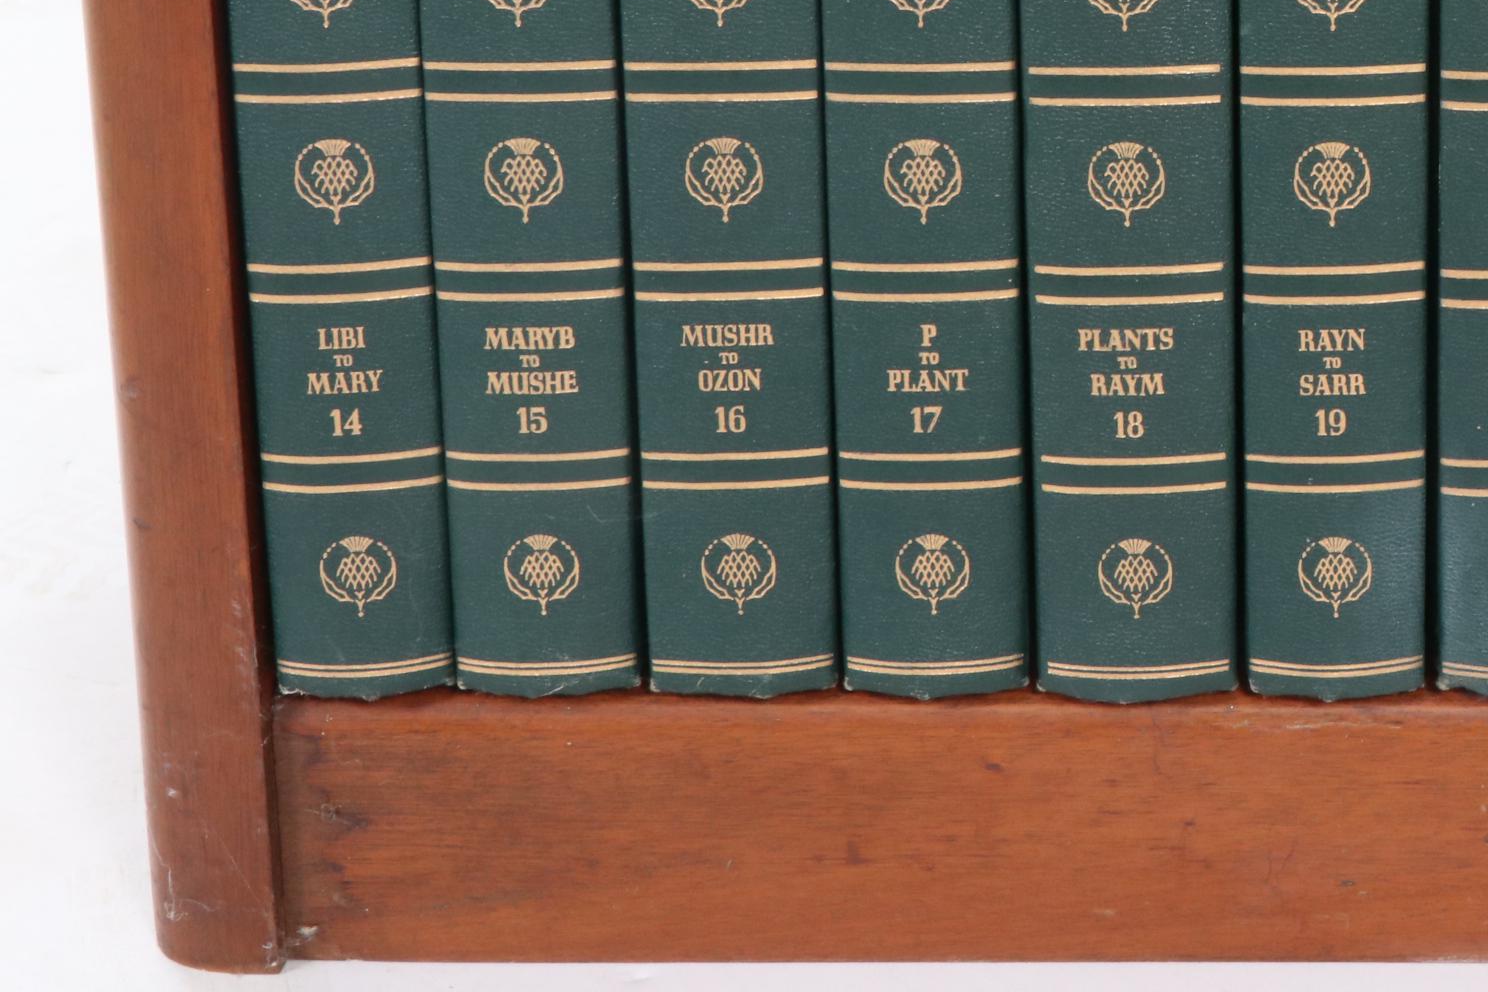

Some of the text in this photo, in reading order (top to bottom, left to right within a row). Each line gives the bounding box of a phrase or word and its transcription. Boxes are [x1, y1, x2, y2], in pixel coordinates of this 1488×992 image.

[319, 327, 365, 349] LIBI
[484, 326, 575, 350] MARYB
[681, 324, 774, 346] MUSHR
[920, 324, 937, 347] P
[1078, 328, 1173, 351] PLANTS
[1298, 329, 1365, 351] RAYN
[334, 354, 353, 367] TO
[520, 355, 540, 368] TO
[720, 352, 739, 365] TO
[919, 352, 939, 365] TO
[1117, 356, 1137, 369] TO
[1323, 356, 1341, 369] TO
[307, 369, 383, 395] MARY
[486, 370, 578, 395] MUSHE
[698, 368, 762, 392] OZON
[887, 369, 968, 392] PLANT
[1299, 374, 1366, 396] SARR
[330, 408, 362, 436] 14
[517, 407, 548, 433] 15
[715, 405, 746, 432] 16
[911, 406, 942, 433] 17
[1114, 411, 1144, 438] 18
[1316, 409, 1346, 436] 19
